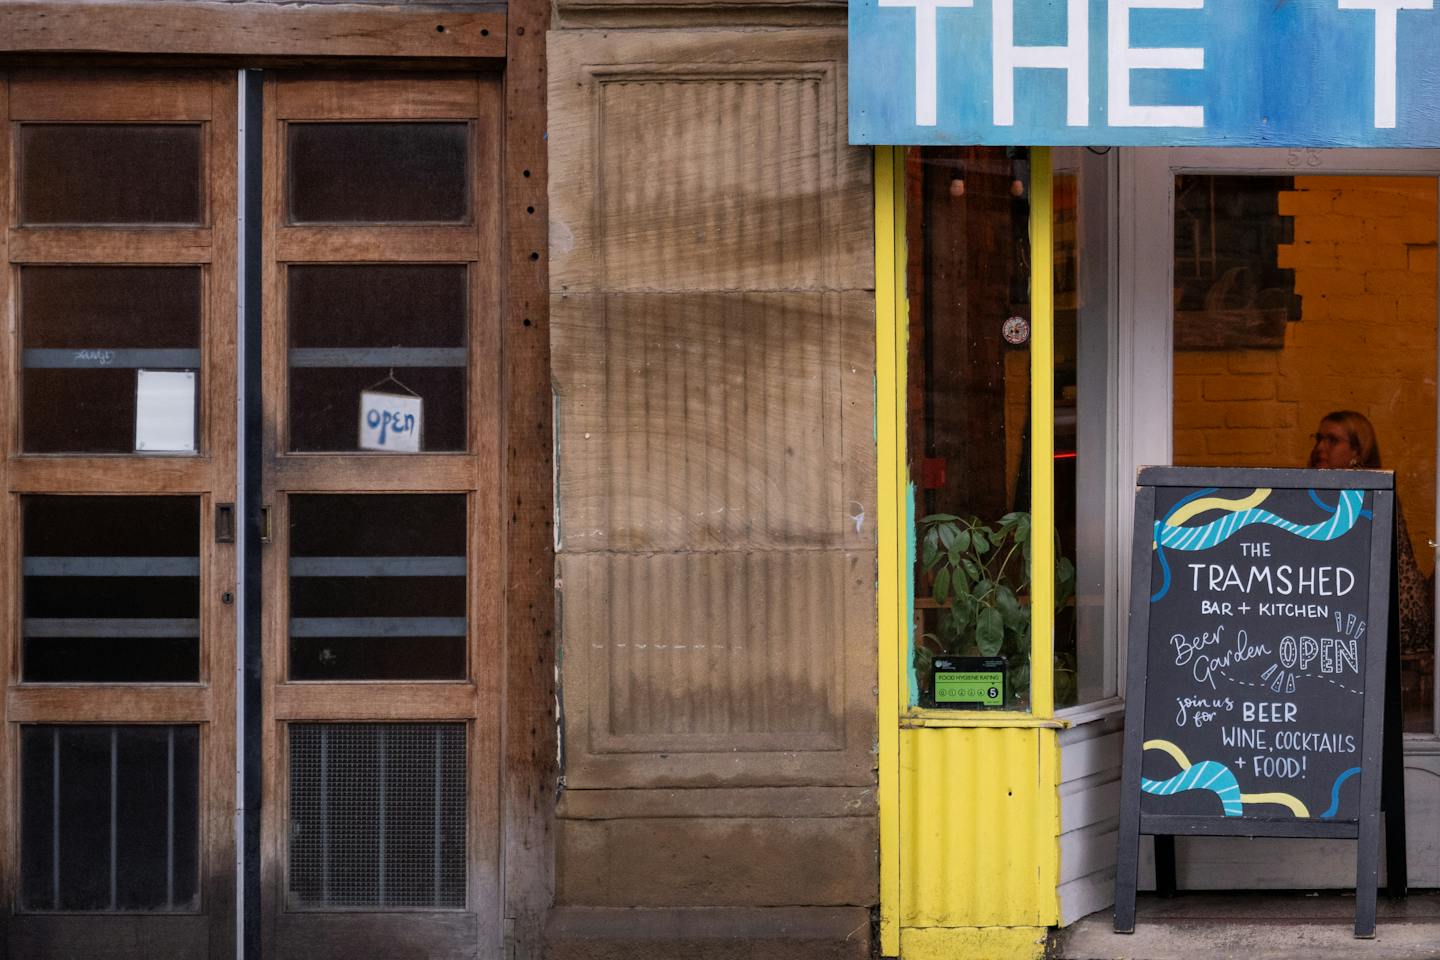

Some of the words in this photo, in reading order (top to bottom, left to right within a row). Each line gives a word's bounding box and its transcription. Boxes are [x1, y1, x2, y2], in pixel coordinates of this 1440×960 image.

[1240, 543, 1272, 557] THE
[1188, 563, 1355, 596] TRAMSHED
[1201, 600, 1234, 616] BAR
[1259, 603, 1329, 618] KITCHEN
[1170, 625, 1225, 666] Beer
[1279, 636, 1359, 674] OPEN
[1193, 629, 1272, 690] Garden
[990, 688, 997, 697] 5
[1176, 695, 1211, 727] join
[1213, 696, 1235, 711] us
[1193, 711, 1217, 728] for
[1242, 701, 1298, 723] BEER
[1222, 726, 1274, 752] WINE,
[1275, 731, 1356, 753] COCKTAILS
[1253, 755, 1307, 779] FOOD!
